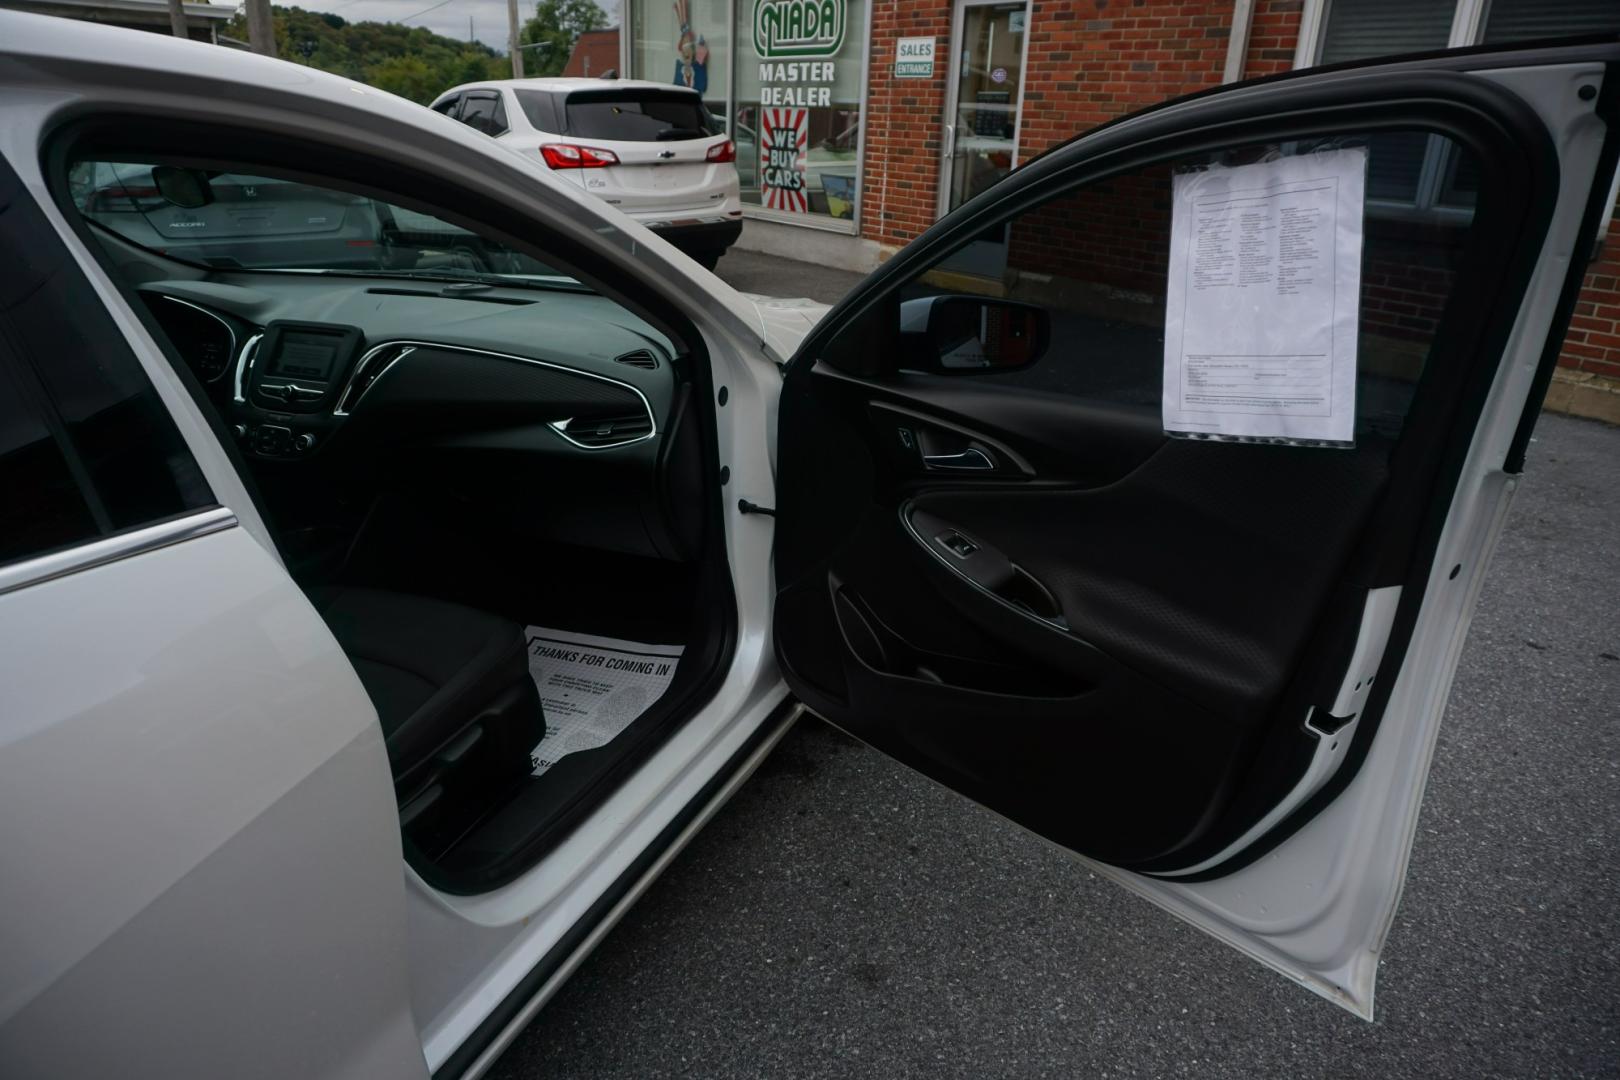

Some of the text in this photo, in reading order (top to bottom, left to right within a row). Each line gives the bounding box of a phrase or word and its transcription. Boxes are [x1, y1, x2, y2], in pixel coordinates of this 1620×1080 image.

[758, 0, 840, 46] NIADA
[900, 44, 932, 56] SALES
[759, 62, 835, 81] MASTER
[897, 63, 931, 74] ENTRANCE
[761, 87, 831, 106] DEALER
[773, 129, 796, 149] WE
[770, 149, 797, 169] BUY
[765, 168, 801, 189] CARS
[533, 646, 670, 676] THANKS FOR COMING IN
